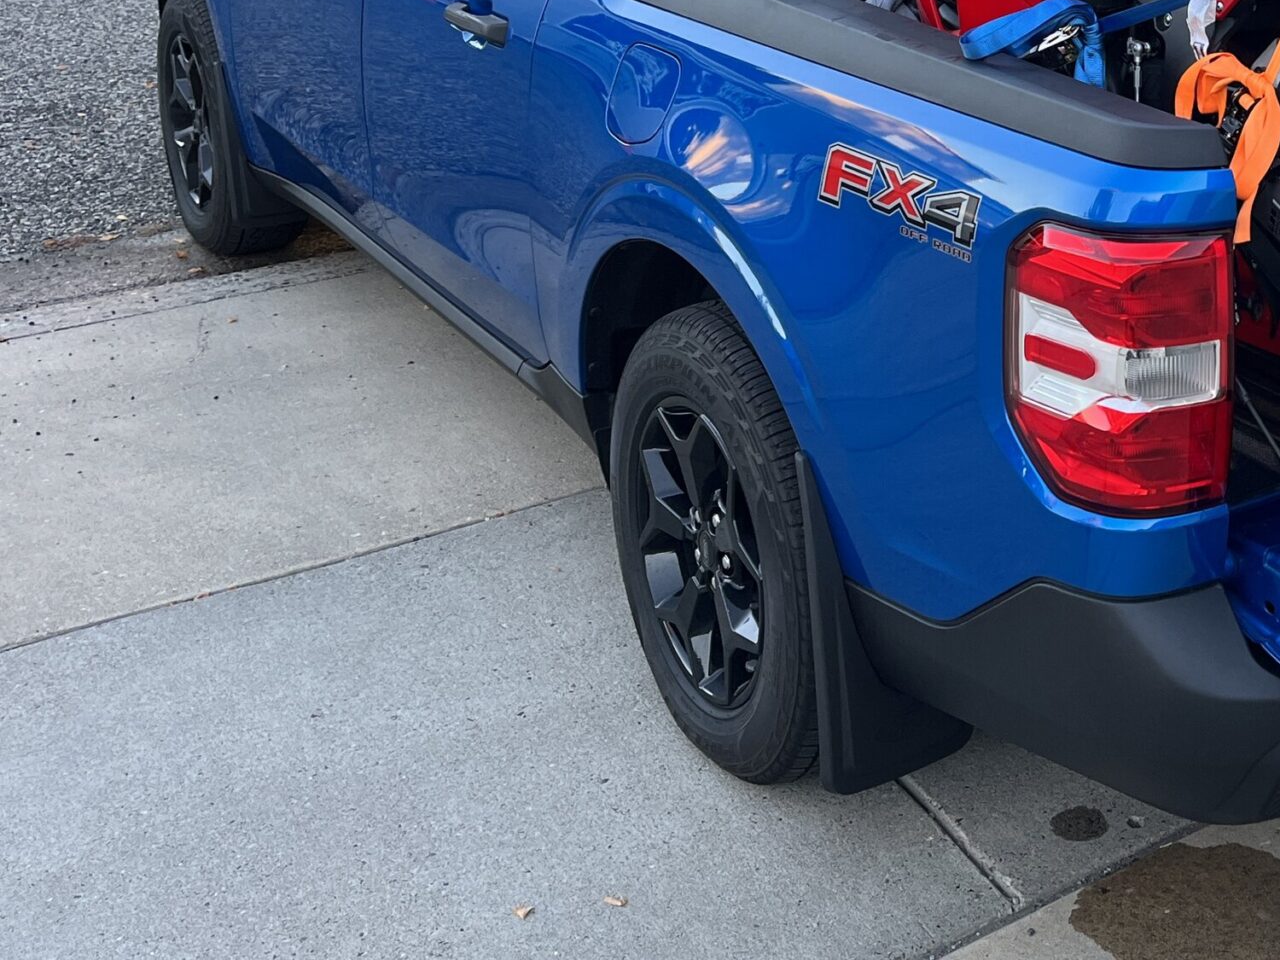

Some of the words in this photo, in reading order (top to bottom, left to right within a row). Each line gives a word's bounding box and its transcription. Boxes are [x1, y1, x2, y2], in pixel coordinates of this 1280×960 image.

[817, 142, 982, 250] FX4
[899, 225, 929, 244] OFF
[932, 239, 972, 263] ROAD
